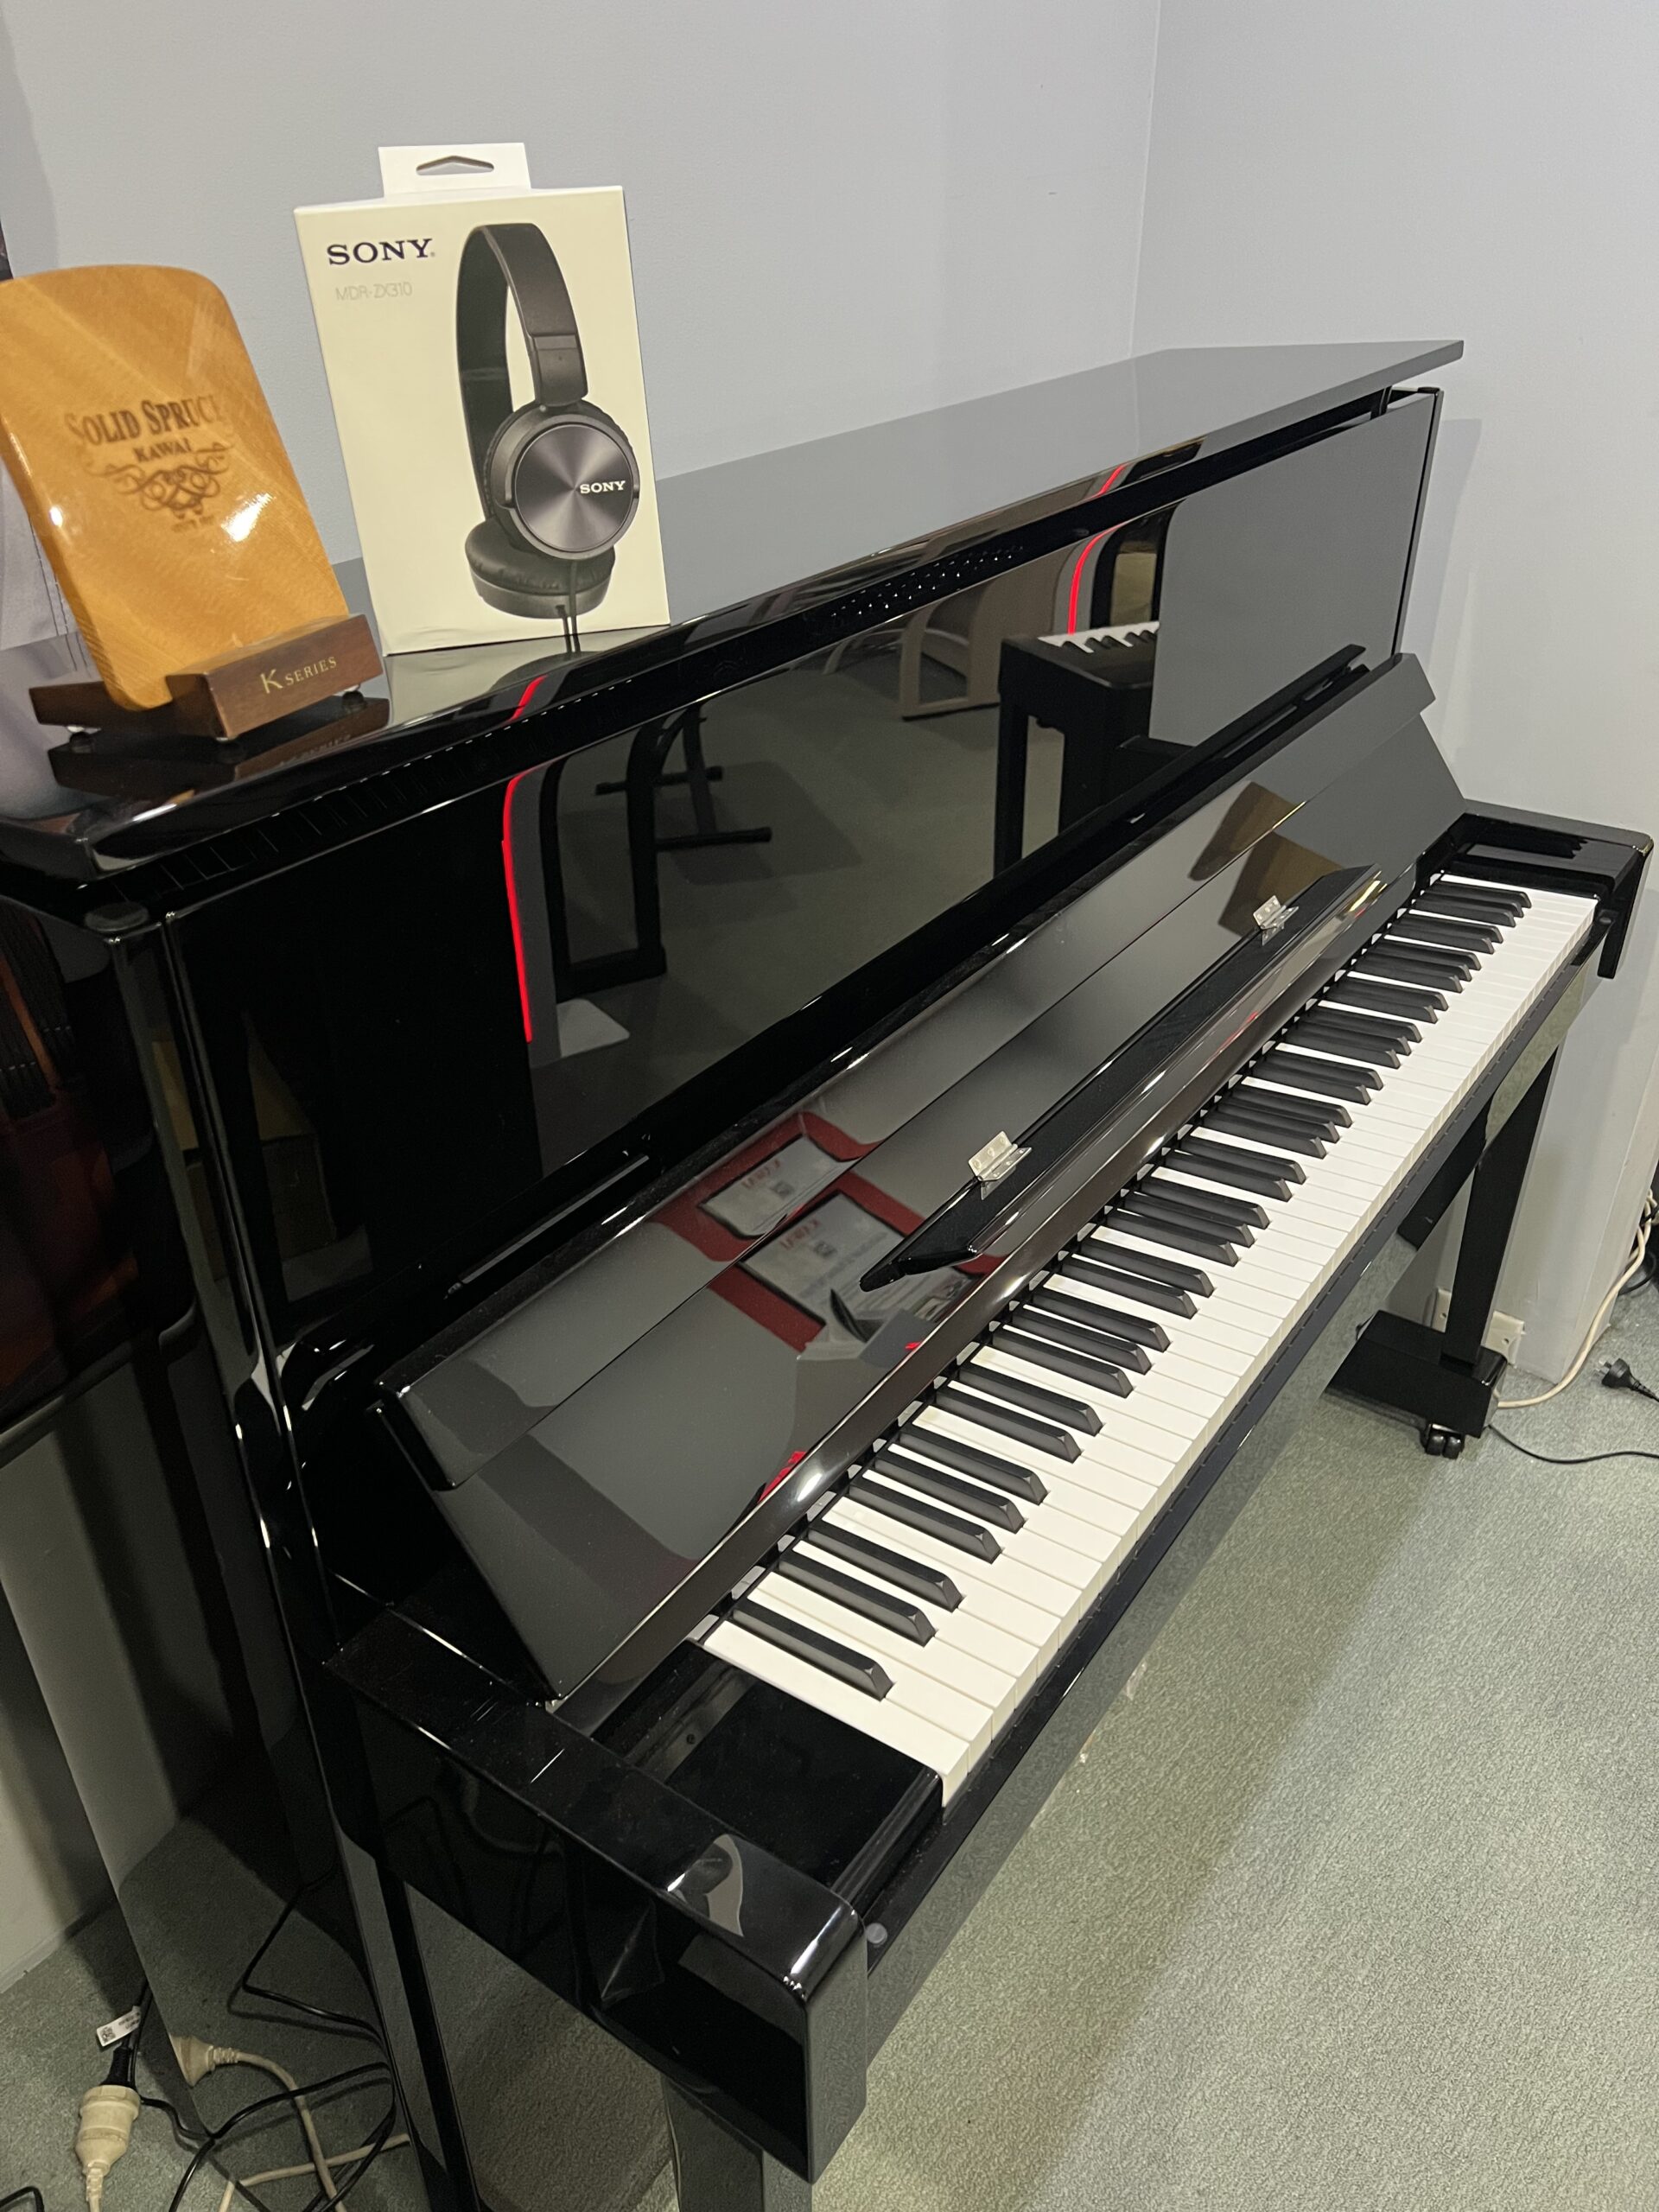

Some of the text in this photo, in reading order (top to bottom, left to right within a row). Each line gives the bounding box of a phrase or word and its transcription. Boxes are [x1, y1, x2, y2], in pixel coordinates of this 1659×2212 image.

[327, 238, 433, 265] SONY
[335, 282, 413, 301] MDR-ZX310
[64, 410, 142, 446] SOLID
[133, 437, 192, 463] KAWAI
[580, 480, 626, 494] SONY
[260, 656, 338, 694] K SERIES
